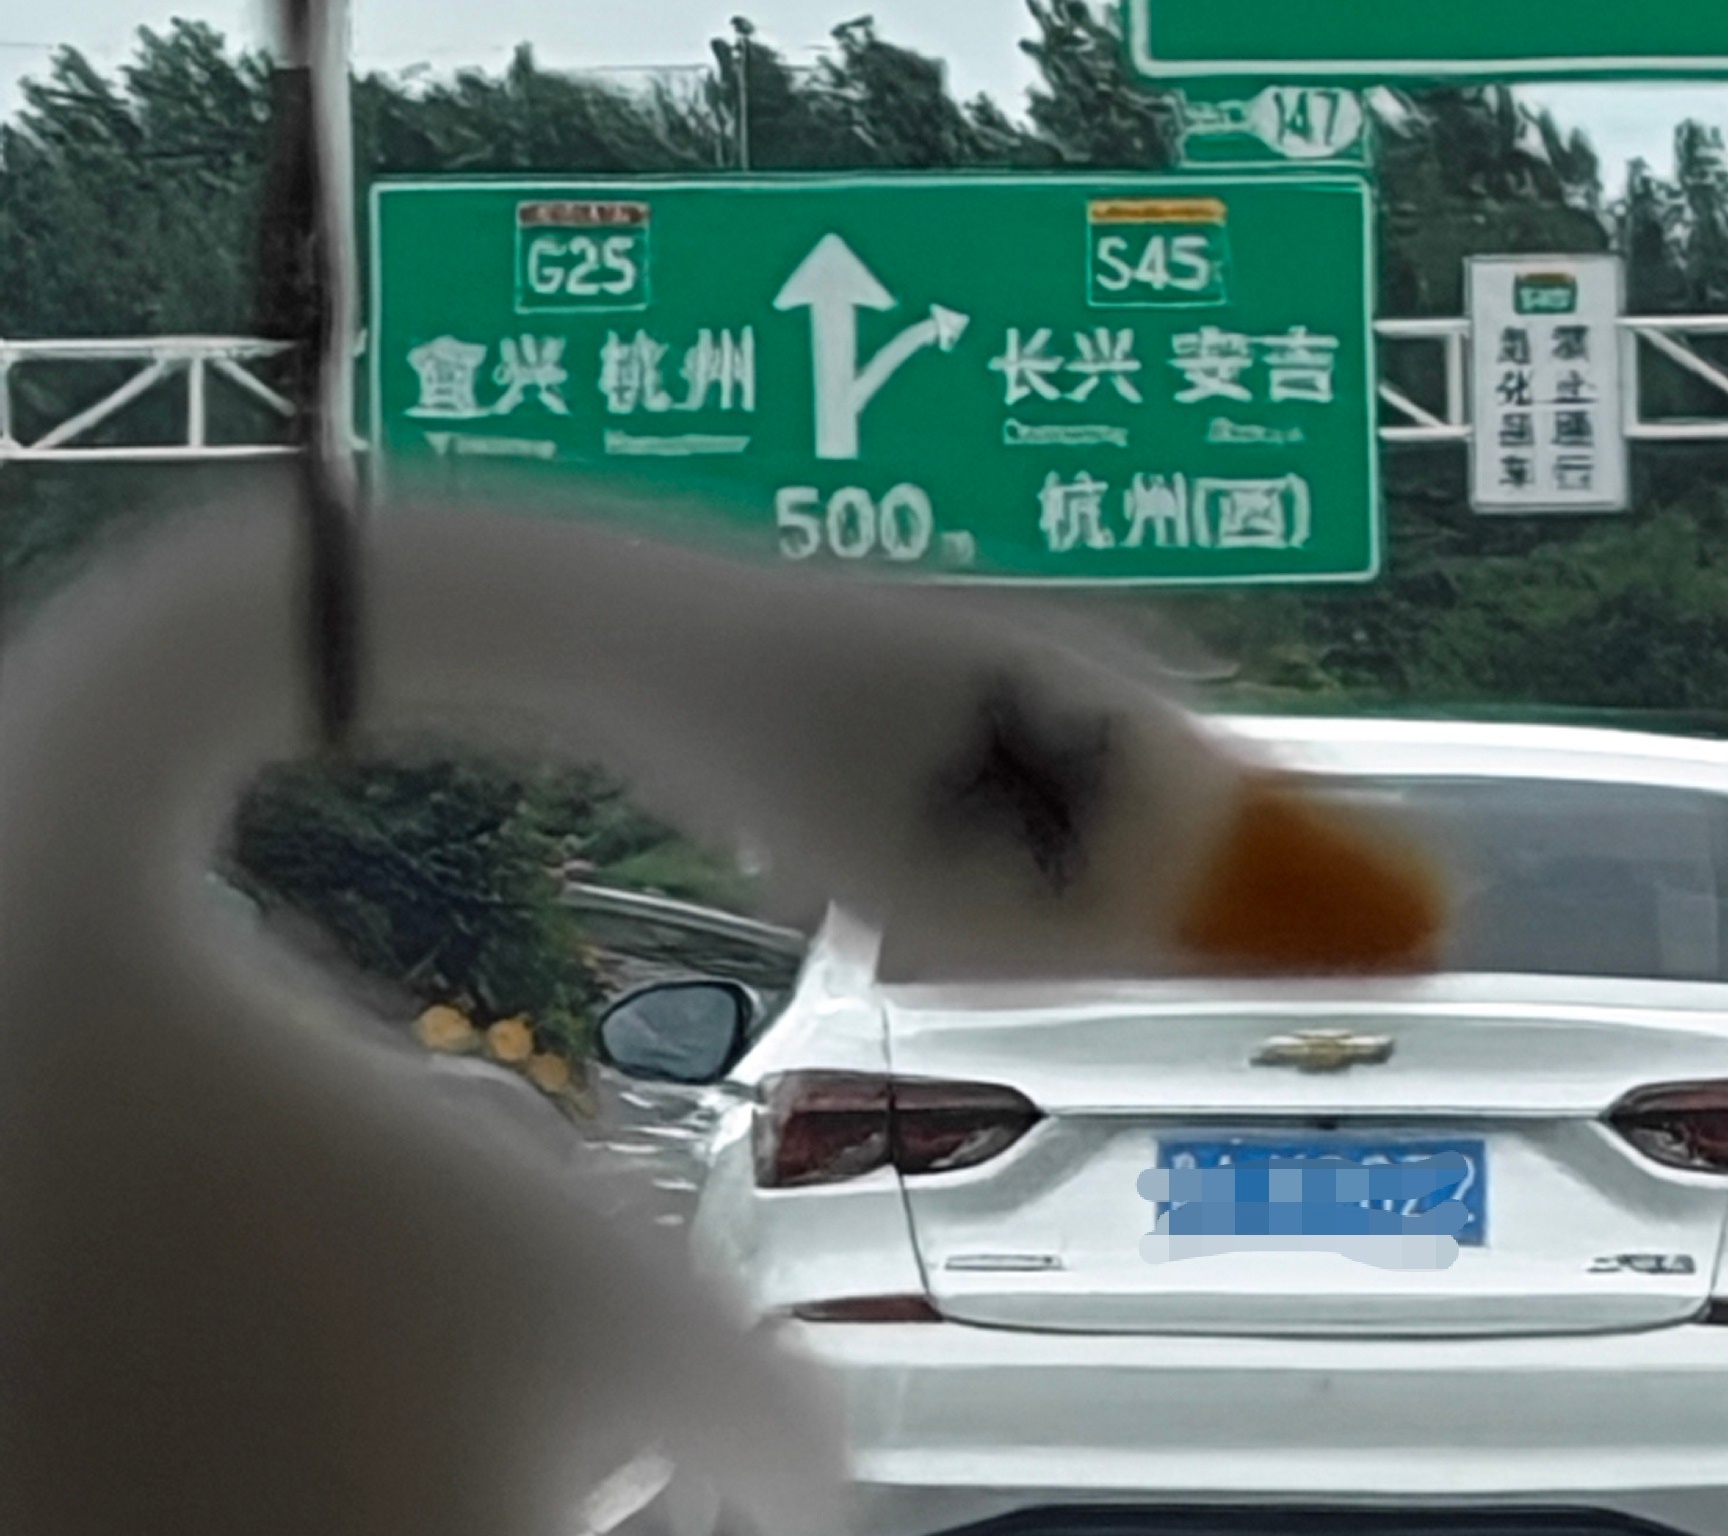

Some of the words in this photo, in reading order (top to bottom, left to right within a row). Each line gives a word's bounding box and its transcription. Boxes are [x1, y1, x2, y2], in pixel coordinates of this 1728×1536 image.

[1273, 91, 1340, 148] 147
[527, 235, 637, 296] G25
[1096, 235, 1211, 292] S45
[988, 327, 1143, 406] 长兴
[775, 482, 934, 562] 500
